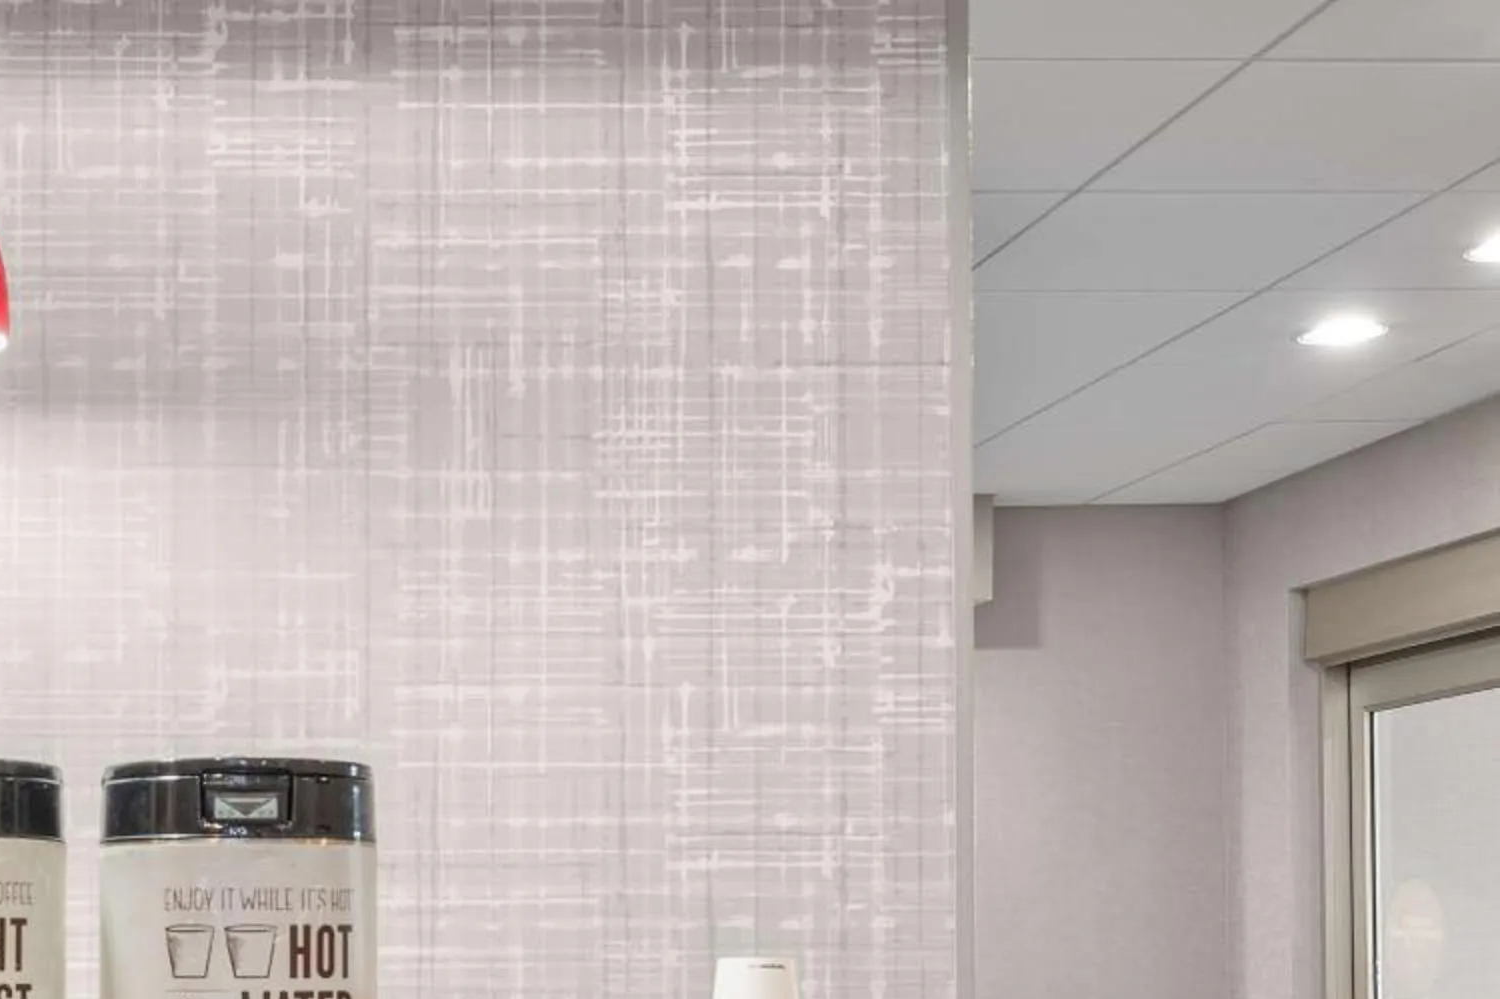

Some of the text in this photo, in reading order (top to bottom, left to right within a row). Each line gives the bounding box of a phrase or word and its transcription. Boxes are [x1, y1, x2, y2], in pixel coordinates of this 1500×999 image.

[164, 887, 215, 912] ENJOY
[220, 887, 235, 910] IT
[240, 887, 293, 910] WHILE
[330, 887, 355, 911] HOT
[289, 924, 353, 979] HOT
